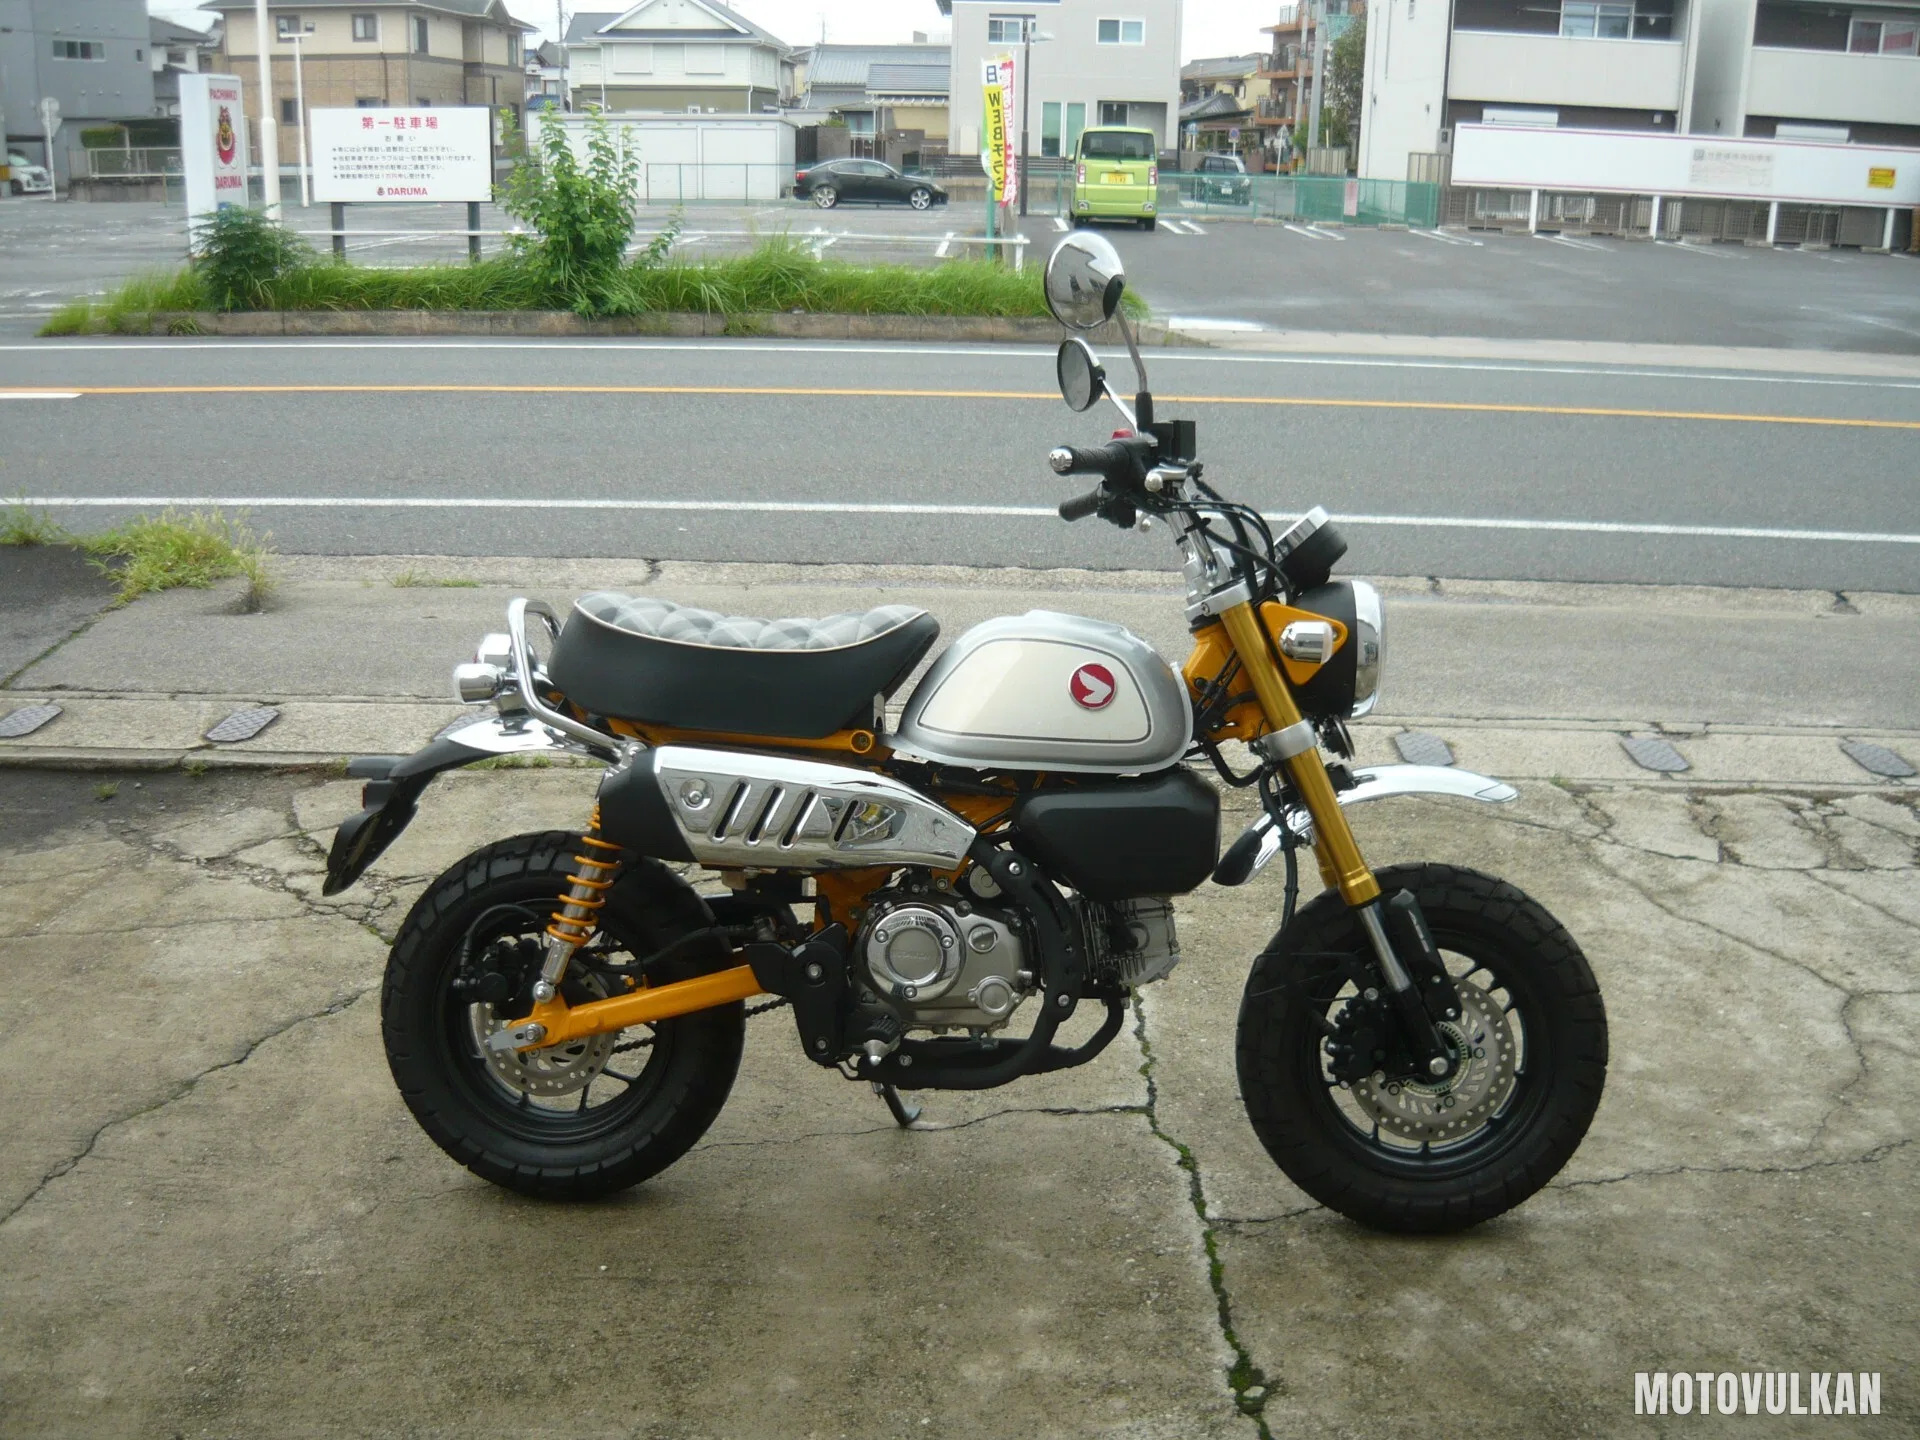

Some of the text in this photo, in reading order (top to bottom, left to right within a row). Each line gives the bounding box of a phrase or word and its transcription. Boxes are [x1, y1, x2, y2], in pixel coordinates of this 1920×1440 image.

[362, 116, 438, 129] 第一駐車場
[215, 175, 242, 190] DARUMA
[387, 187, 428, 196] DARUMA
